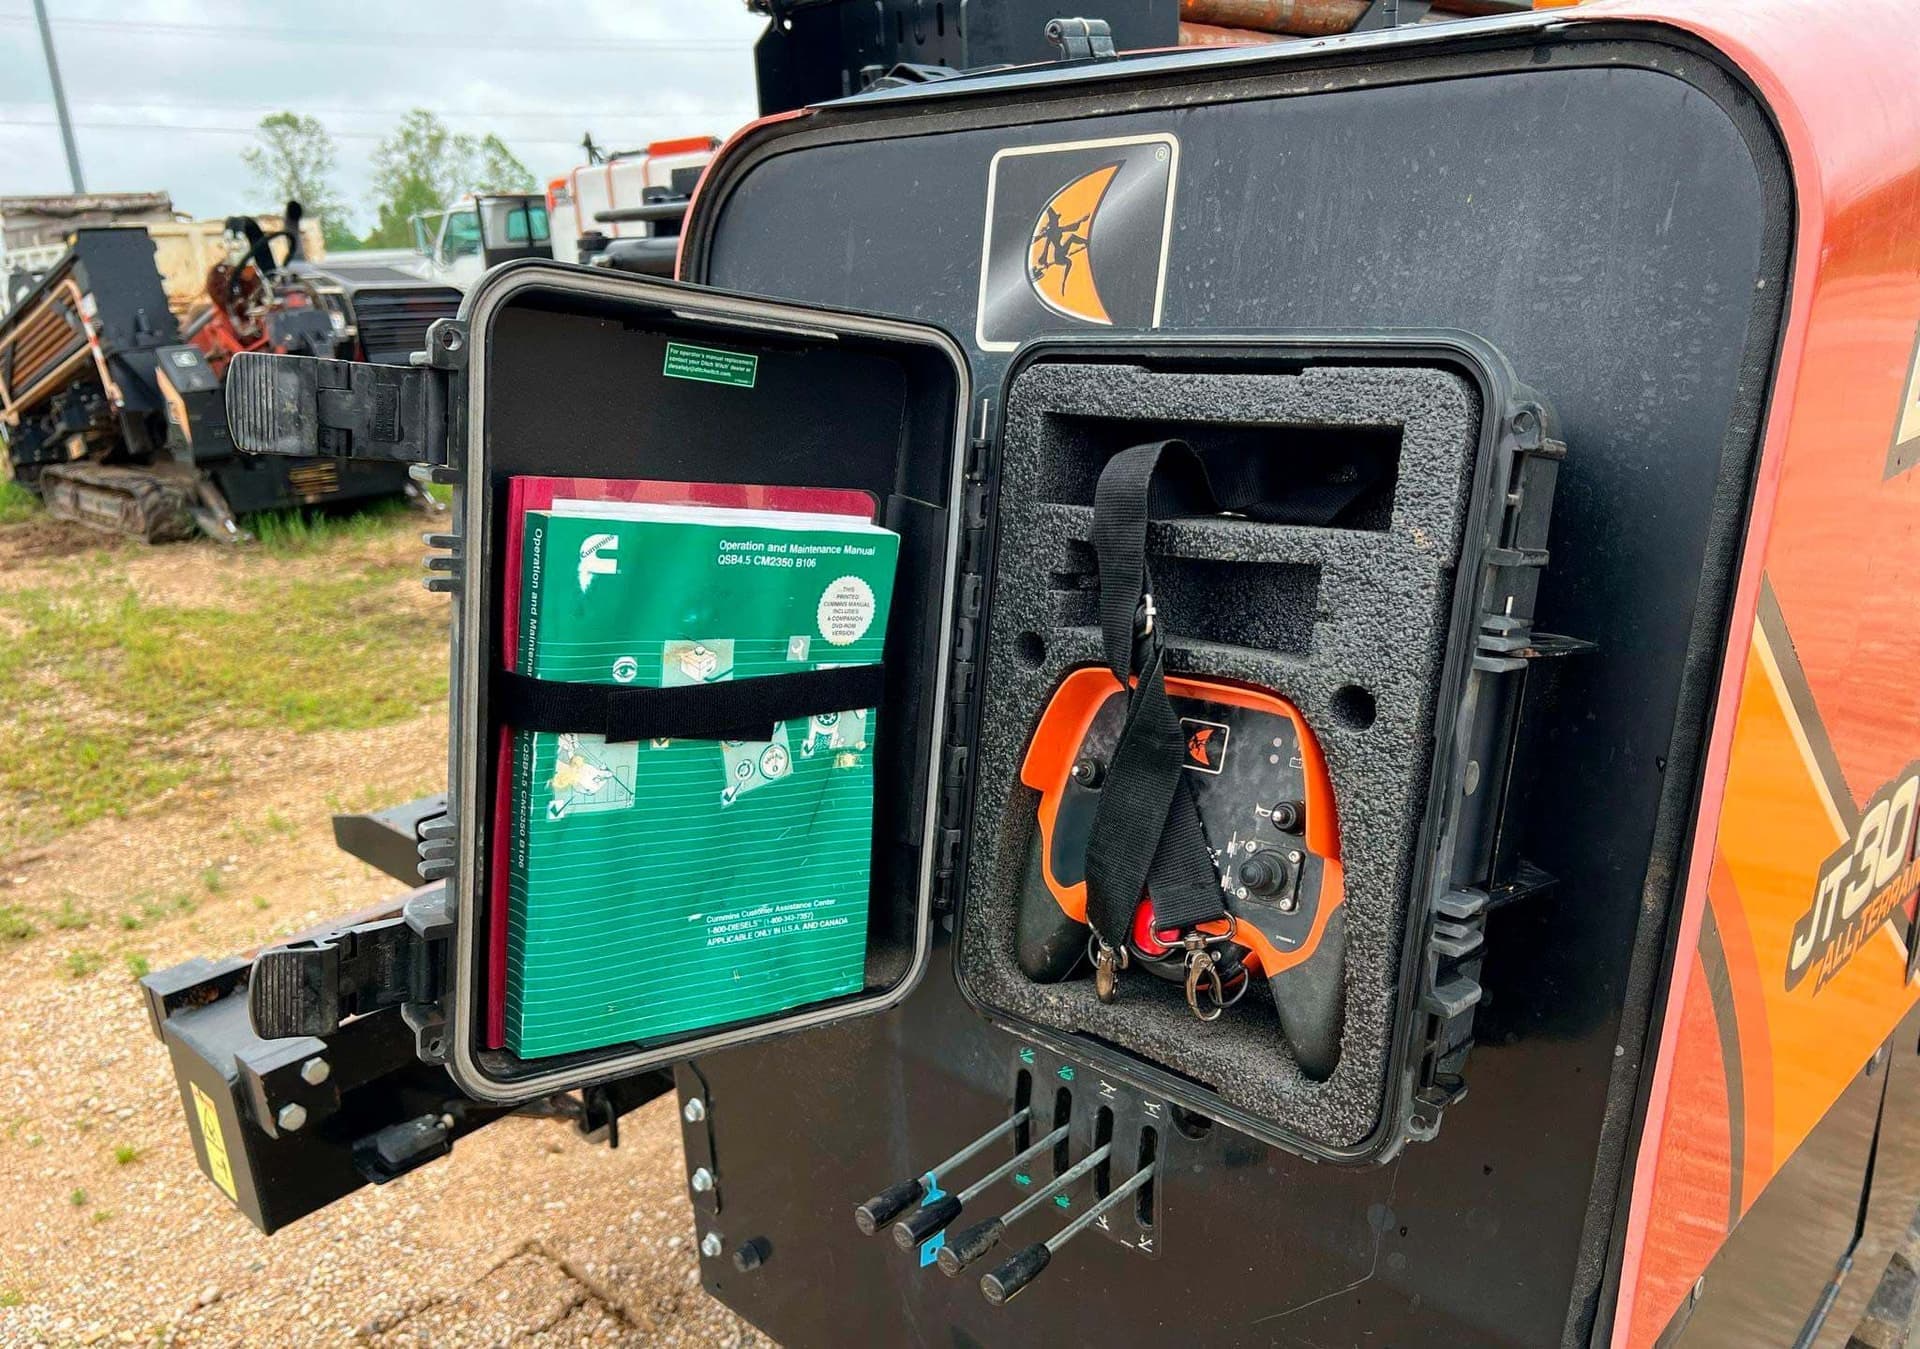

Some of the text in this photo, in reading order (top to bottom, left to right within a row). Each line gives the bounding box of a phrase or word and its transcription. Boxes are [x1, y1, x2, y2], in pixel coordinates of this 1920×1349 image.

[532, 528, 543, 588] Operation
[581, 535, 614, 558] Cummins
[719, 540, 875, 556] Operation and Maintenance Manual
[718, 555, 816, 568] QSB4.5 CM2350 B106
[530, 592, 538, 616] and
[1791, 775, 1920, 971] JT30
[706, 899, 836, 924] Cummins Customer Assistance Center
[706, 931, 752, 946] APPLICABLE
[754, 928, 772, 938] ONLY
[774, 927, 781, 935] IN
[802, 921, 819, 930] AND
[820, 916, 849, 928] CANADA
[1818, 922, 1853, 985] ALL
